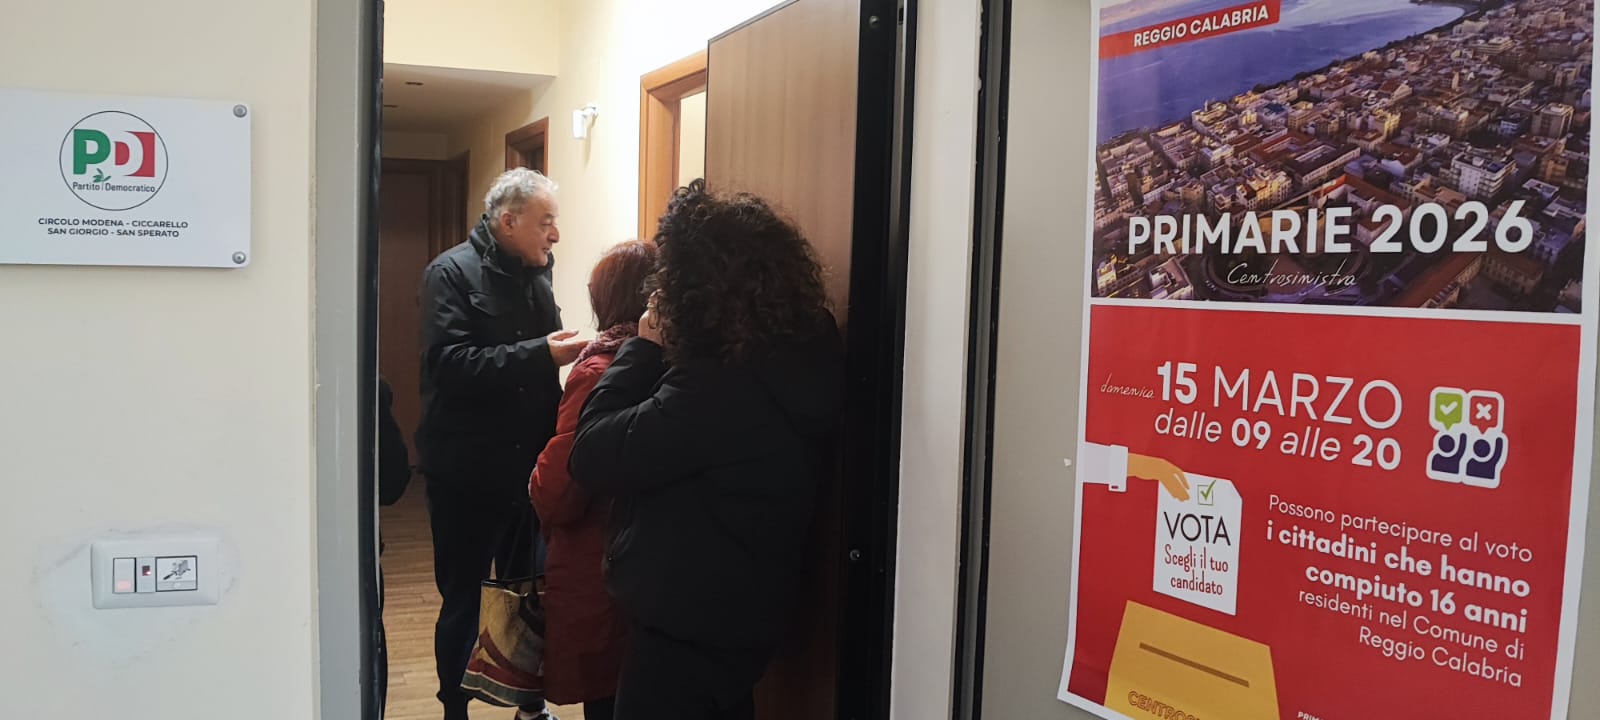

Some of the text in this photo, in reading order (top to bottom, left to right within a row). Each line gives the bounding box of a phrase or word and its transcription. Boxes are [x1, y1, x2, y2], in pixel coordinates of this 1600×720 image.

[1133, 5, 1269, 48] REGGIO CALABRIA
[73, 128, 155, 177] PD
[72, 182, 156, 192] Partito Democratico
[38, 218, 80, 226] CIRCOLO
[82, 219, 124, 227] MODENA
[131, 220, 189, 228] CICCARELLO
[69, 228, 109, 236] GIORGIO
[137, 229, 180, 238] SPERATO
[1128, 199, 1535, 255] PRIMARIE 2026
[1227, 258, 1360, 287] Centrosinistra
[1156, 360, 1198, 405] 15
[1213, 365, 1403, 430] MARZO
[1154, 407, 1402, 471] dalle 09 alle 20
[1163, 511, 1231, 546] VOTA
[1269, 494, 1533, 563] Possono partecipare al voto
[1164, 543, 1229, 573] Scegli il tuo
[1266, 519, 1531, 598] i cittadini che hanno
[1170, 569, 1223, 596] candidato
[1305, 565, 1528, 634] compiuto 16 anni
[1299, 590, 1525, 661] residenti nel Comune di
[1359, 626, 1522, 688] Reggio Calabria
[1128, 690, 1200, 720] CENTRO
[1297, 711, 1324, 720] PRIM
